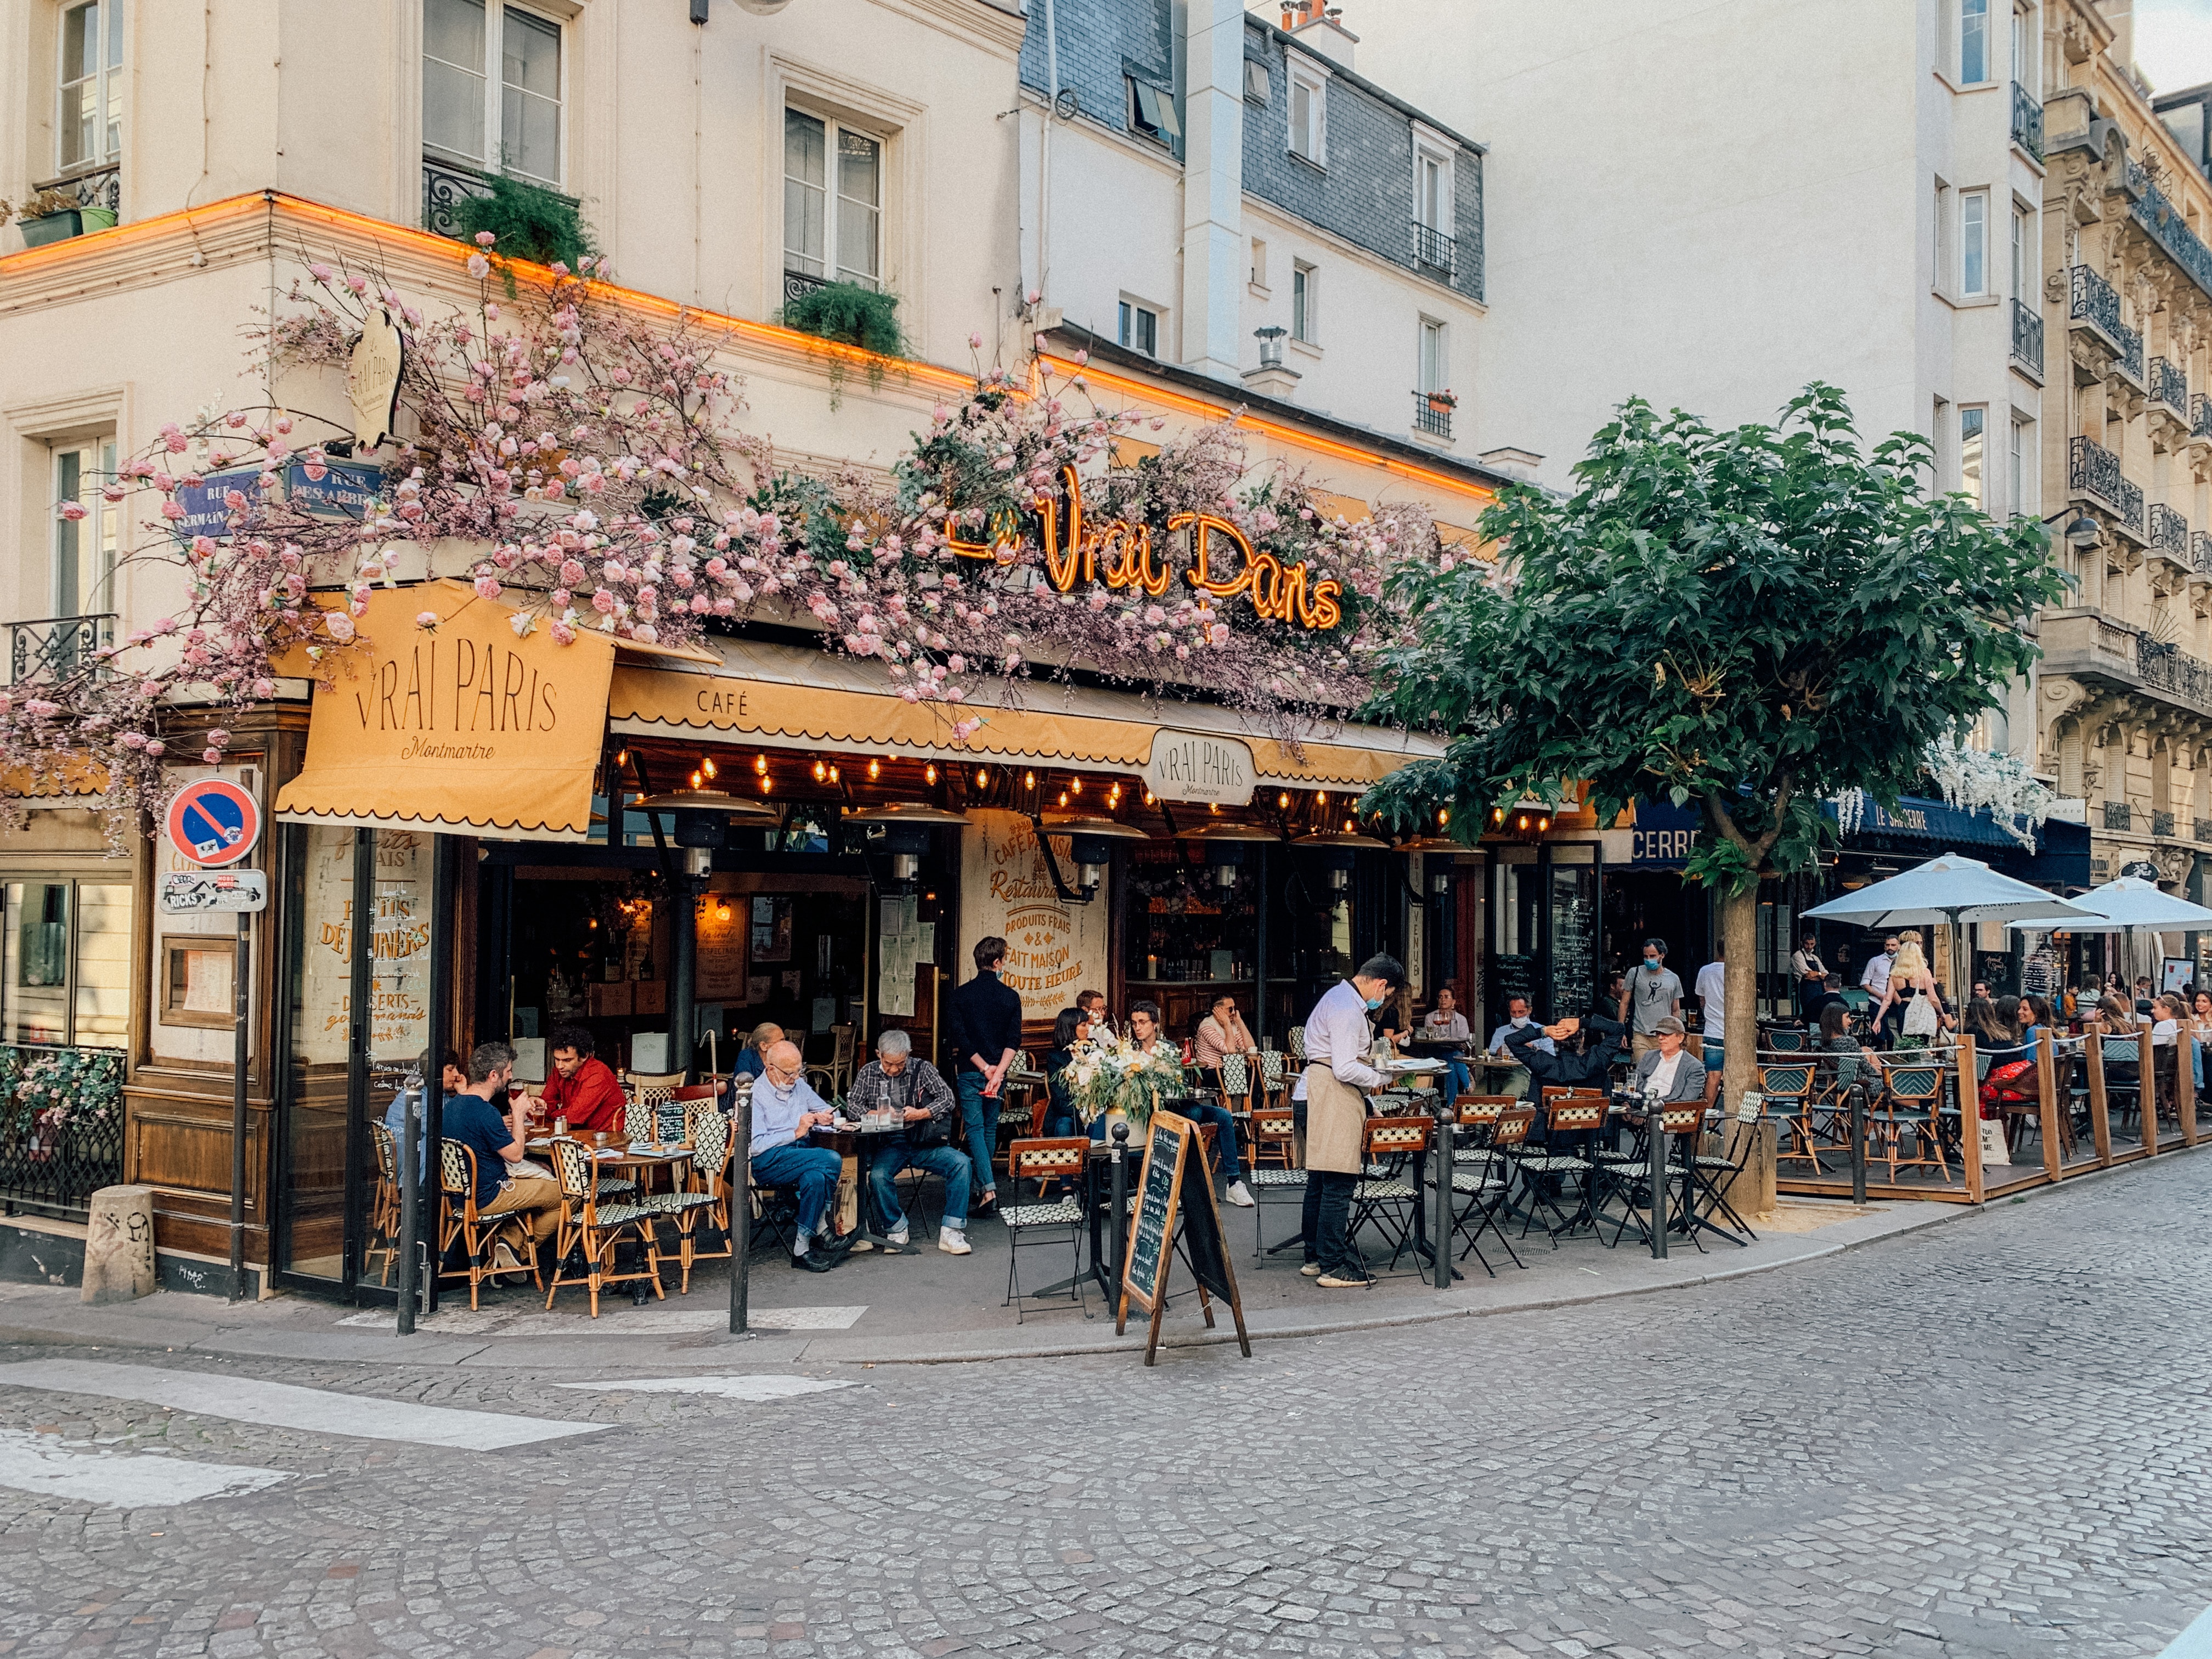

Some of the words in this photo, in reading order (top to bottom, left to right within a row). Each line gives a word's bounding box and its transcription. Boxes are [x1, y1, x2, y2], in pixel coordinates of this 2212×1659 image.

[358, 360, 370, 396] RAI
[373, 356, 393, 388] PARIS
[332, 472, 366, 488] RUE
[207, 486, 230, 500] RUE
[1035, 464, 1170, 596] Vrai
[356, 641, 435, 731] VRAI
[454, 639, 557, 732] PARIS
[697, 691, 747, 715] CAFÉ
[402, 736, 495, 759] Montmartre
[1159, 741, 1195, 781] VRAI
[1204, 742, 1243, 787] PARIS
[1182, 783, 1220, 796] Montmartre
[1876, 805, 1886, 826] LE
[994, 831, 1027, 865] CAFÉ
[170, 893, 198, 908] RICKS
[1005, 914, 1046, 936] PRODUITS
[1048, 915, 1071, 934] FRAIS
[320, 922, 429, 964] DÉJUNERS
[1035, 932, 1042, 946] &
[1005, 945, 1029, 968] FAIT
[1031, 944, 1069, 968] MAISON
[1003, 969, 1042, 990] TOUTE
[1045, 960, 1083, 989] HEURE
